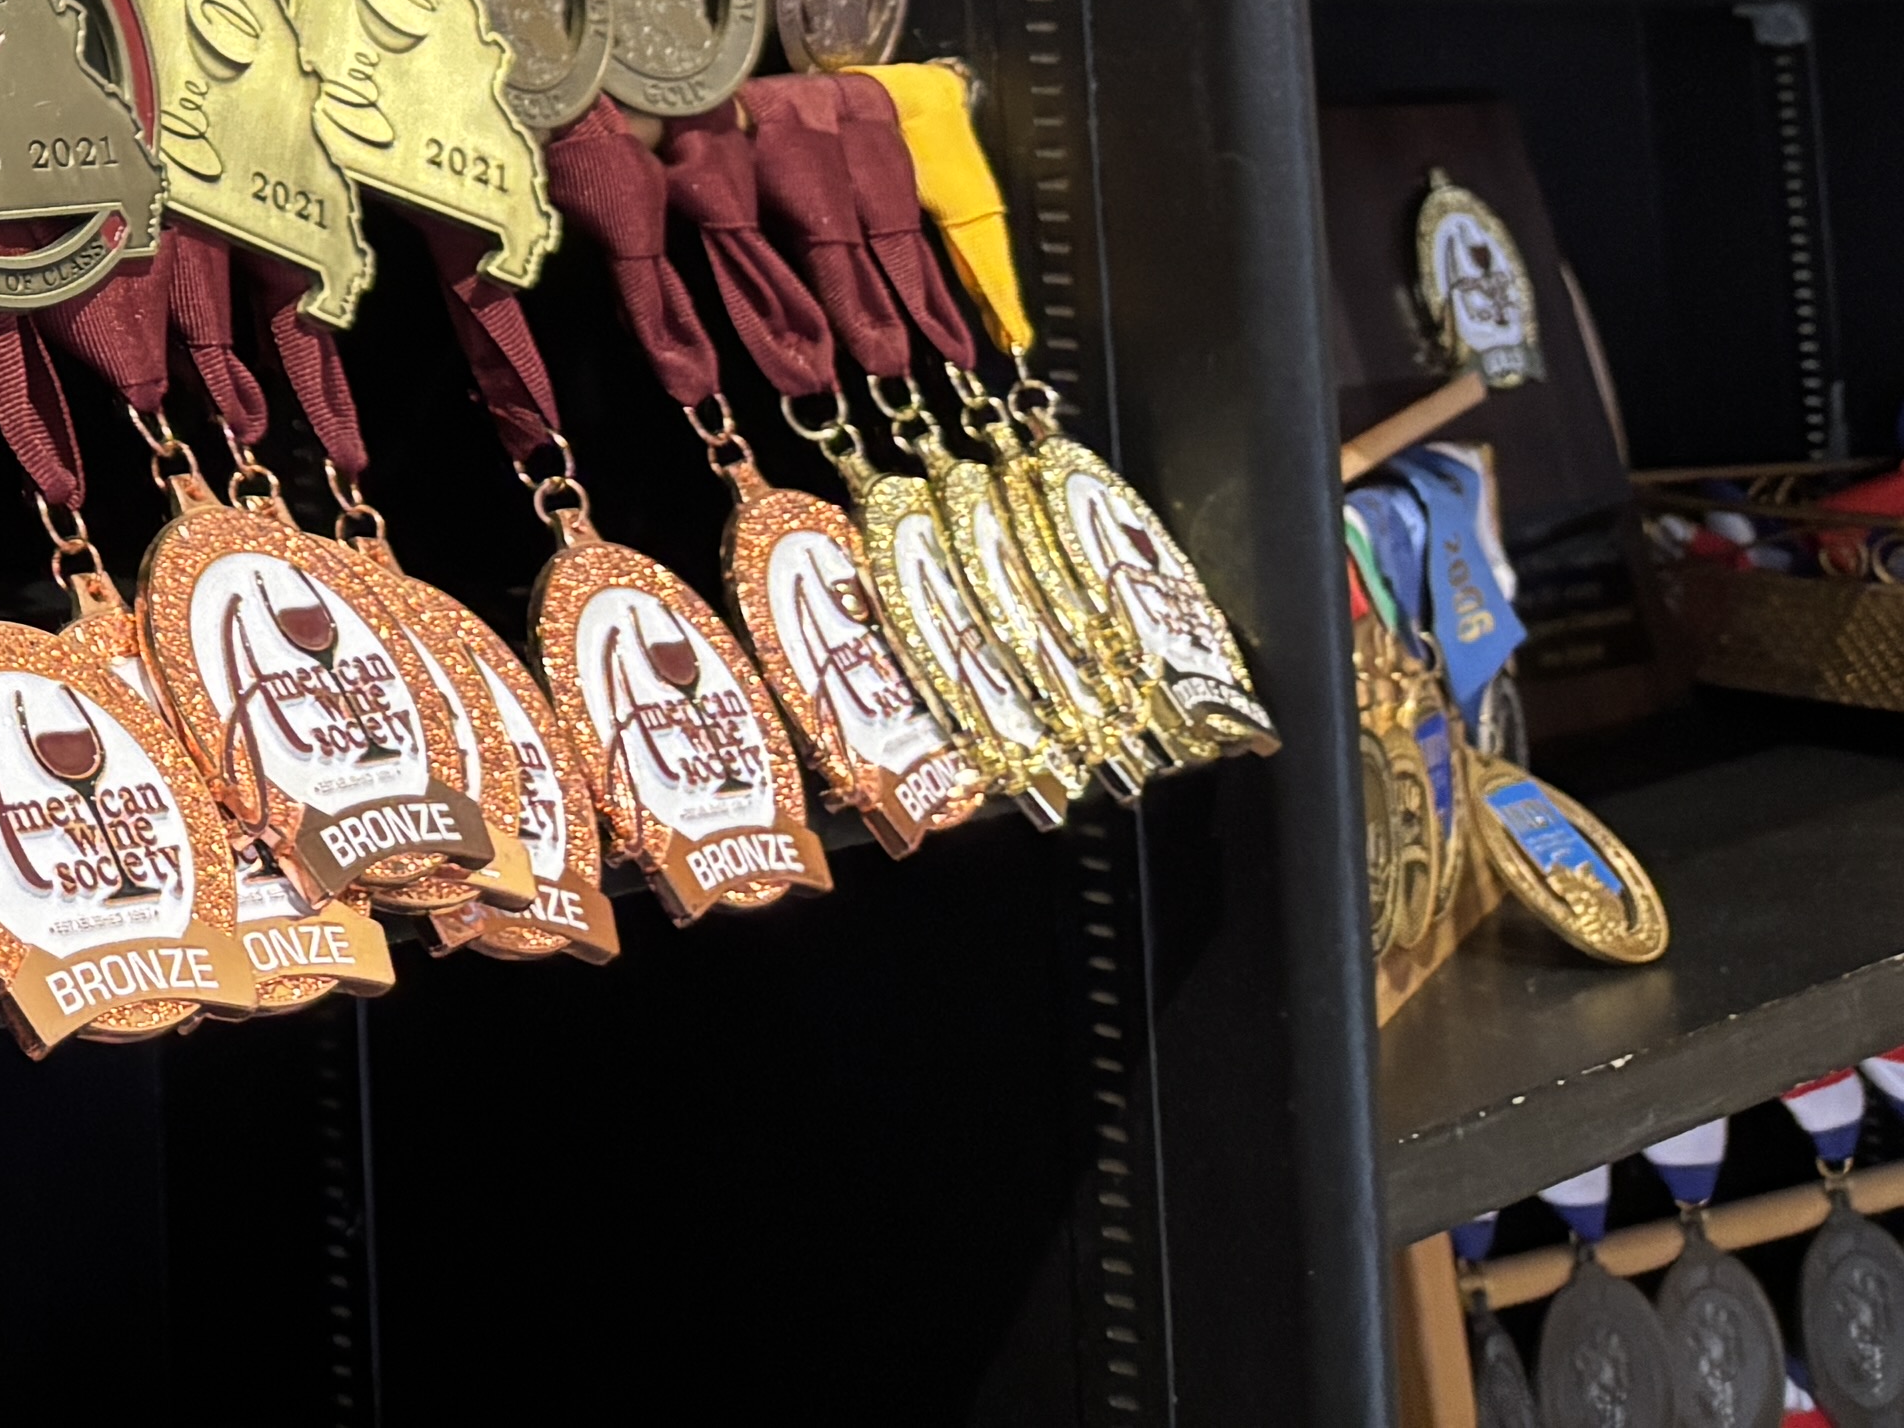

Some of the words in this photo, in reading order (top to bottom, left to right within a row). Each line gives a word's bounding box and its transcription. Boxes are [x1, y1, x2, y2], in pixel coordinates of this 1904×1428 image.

[319, 801, 463, 868] BRONZE
[685, 835, 804, 890] BRONZE
[45, 949, 220, 1016] BRONZE
